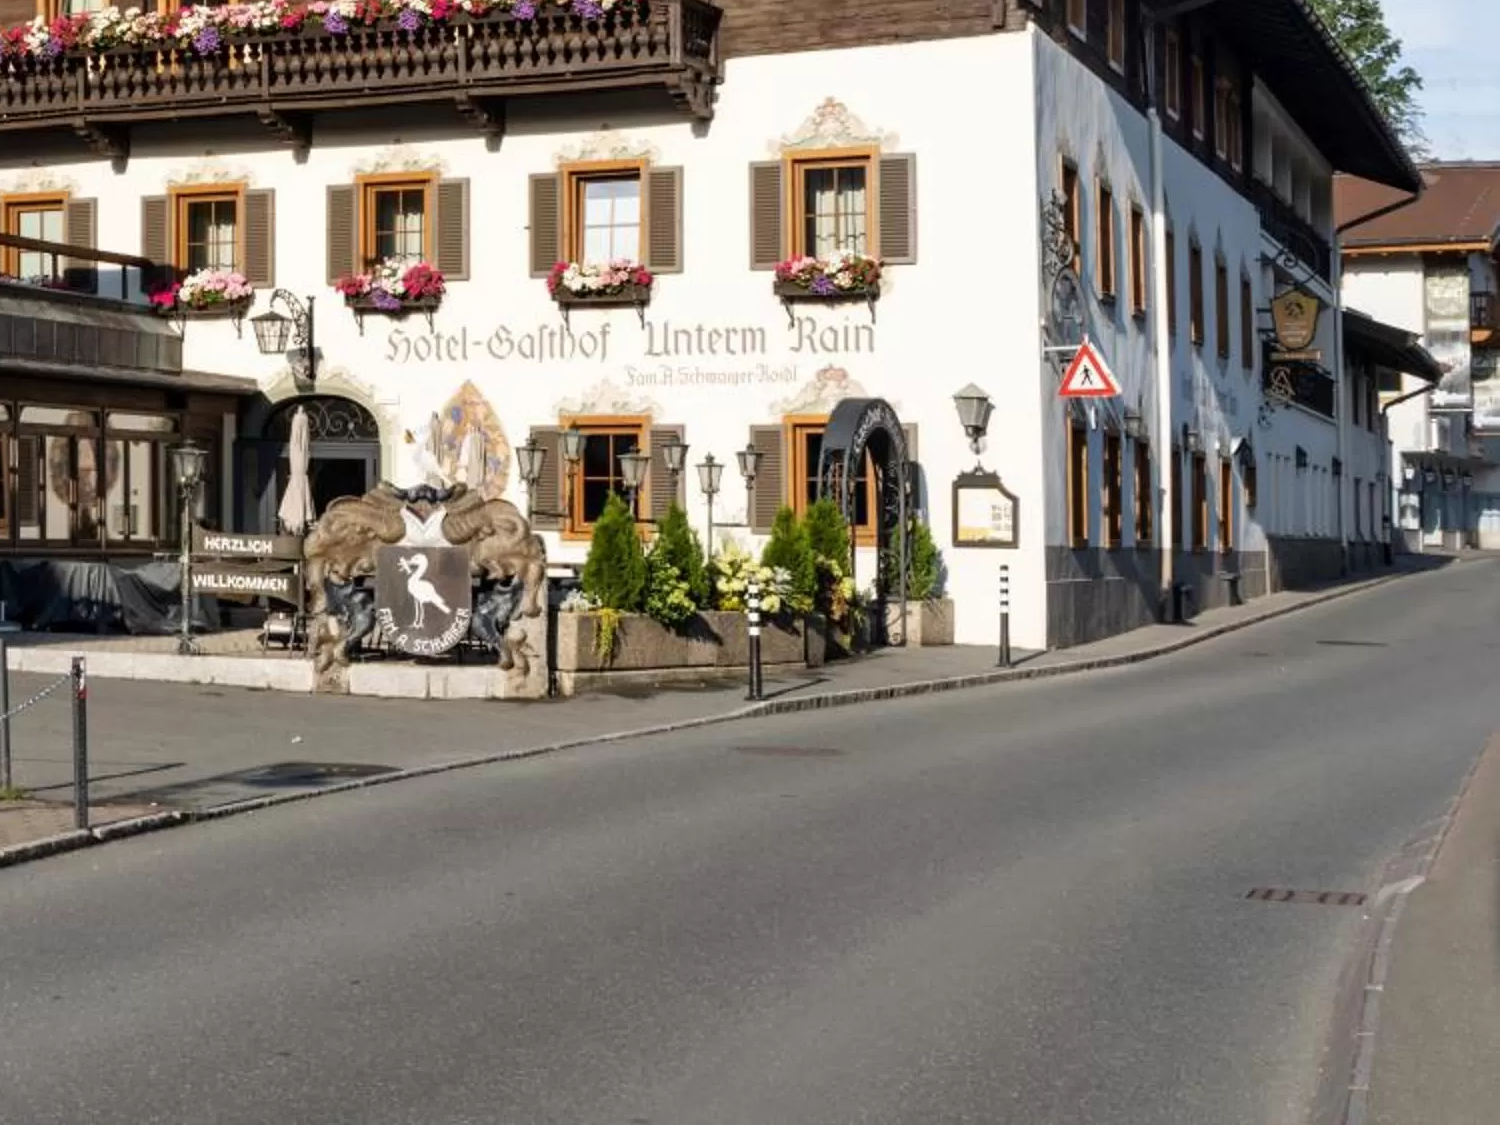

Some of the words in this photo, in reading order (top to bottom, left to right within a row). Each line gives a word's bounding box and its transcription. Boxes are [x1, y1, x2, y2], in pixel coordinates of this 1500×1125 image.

[644, 320, 766, 358] Unterm
[791, 316, 876, 354] Rain
[204, 535, 273, 554] HERZLICH
[192, 575, 288, 592] WILLKOMMEN
